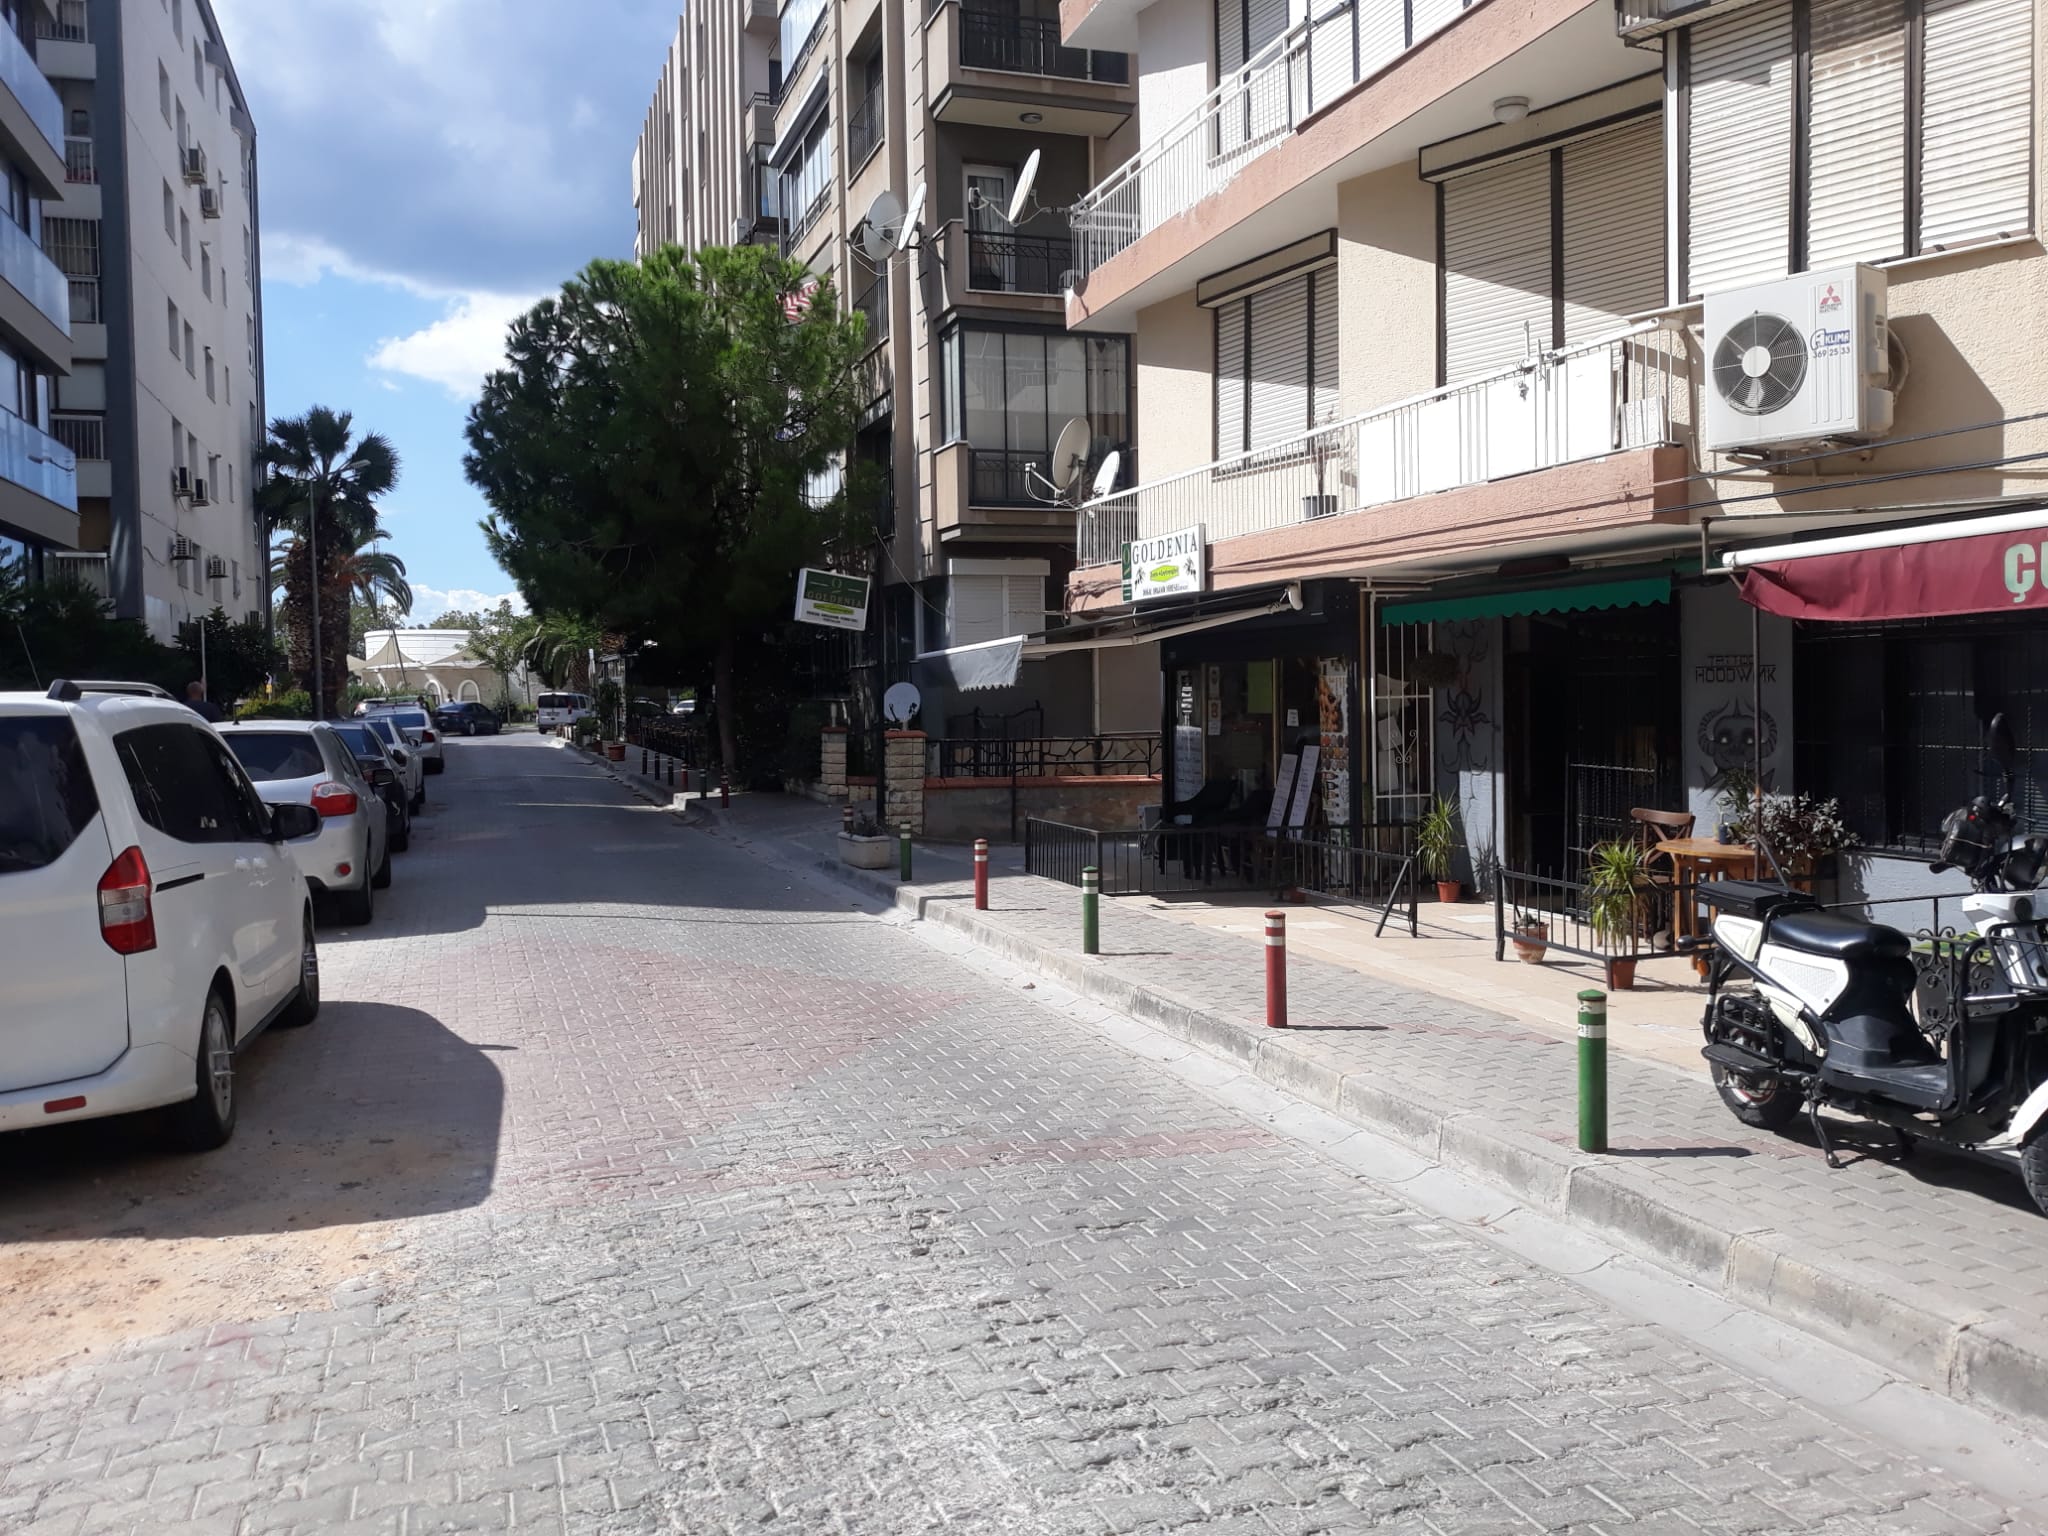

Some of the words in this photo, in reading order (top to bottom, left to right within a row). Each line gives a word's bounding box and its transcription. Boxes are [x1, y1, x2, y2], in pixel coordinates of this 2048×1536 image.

[1829, 348, 1839, 357] 25
[1132, 531, 1198, 564] GOLDENIA
[2004, 541, 2048, 603] Ç
[807, 591, 863, 607] GOLDENIA
